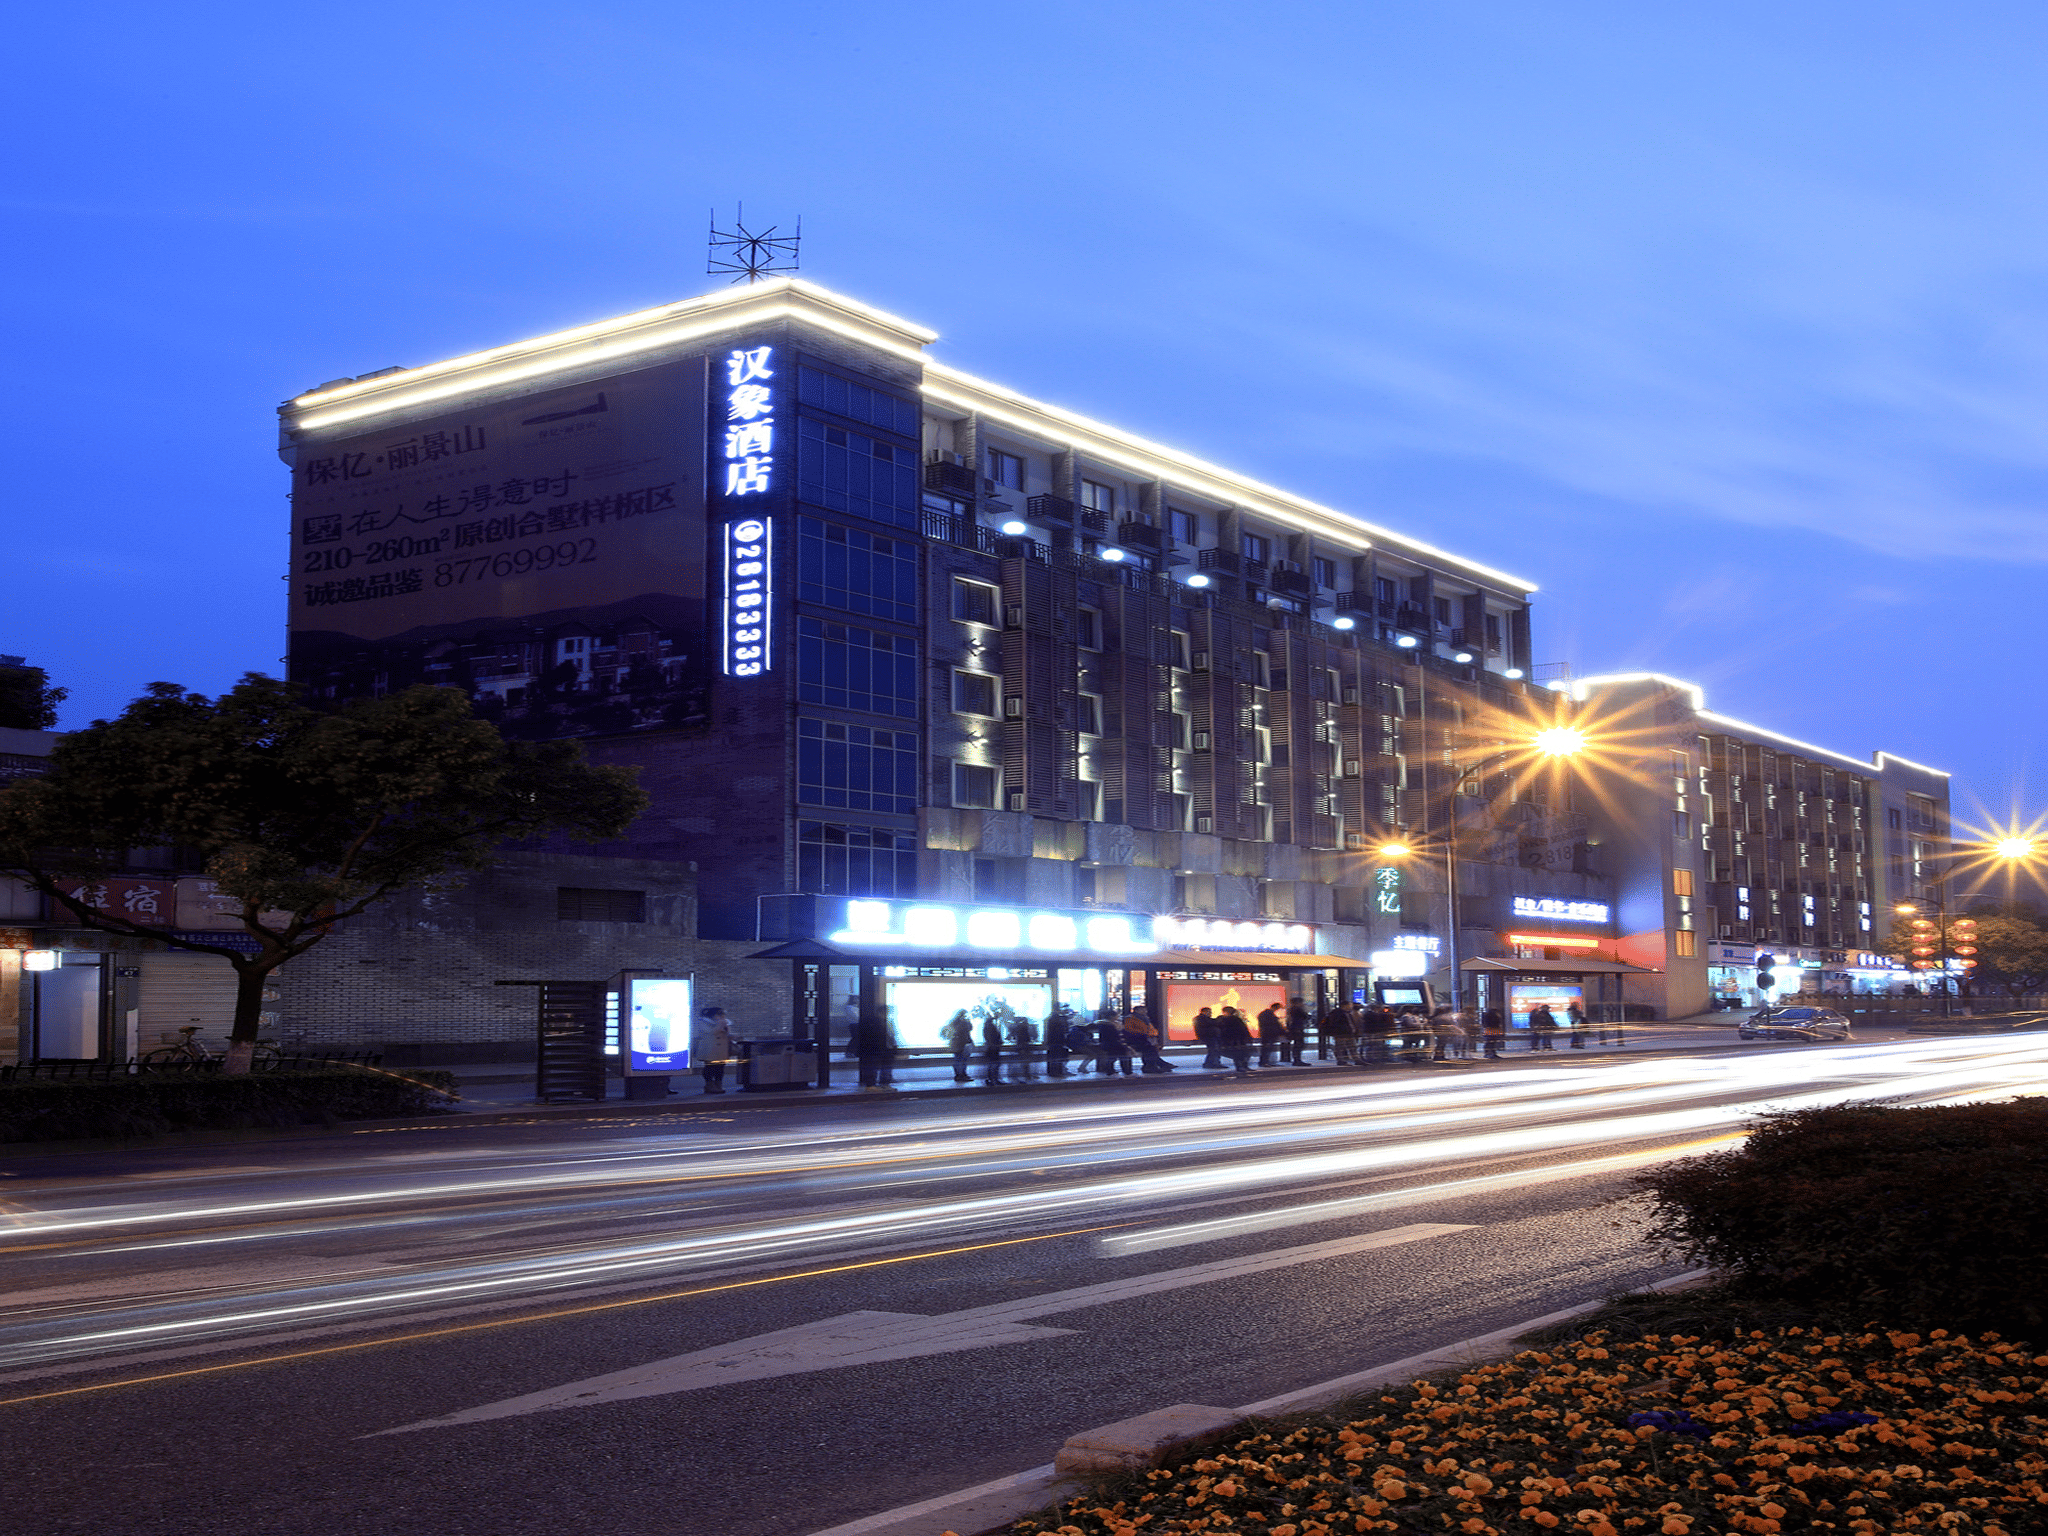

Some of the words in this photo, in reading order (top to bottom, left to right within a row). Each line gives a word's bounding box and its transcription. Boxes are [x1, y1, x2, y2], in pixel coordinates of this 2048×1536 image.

[305, 426, 487, 487] 保亿·丽景山
[434, 537, 598, 588] 87769992
[69, 884, 162, 915] 住宿
